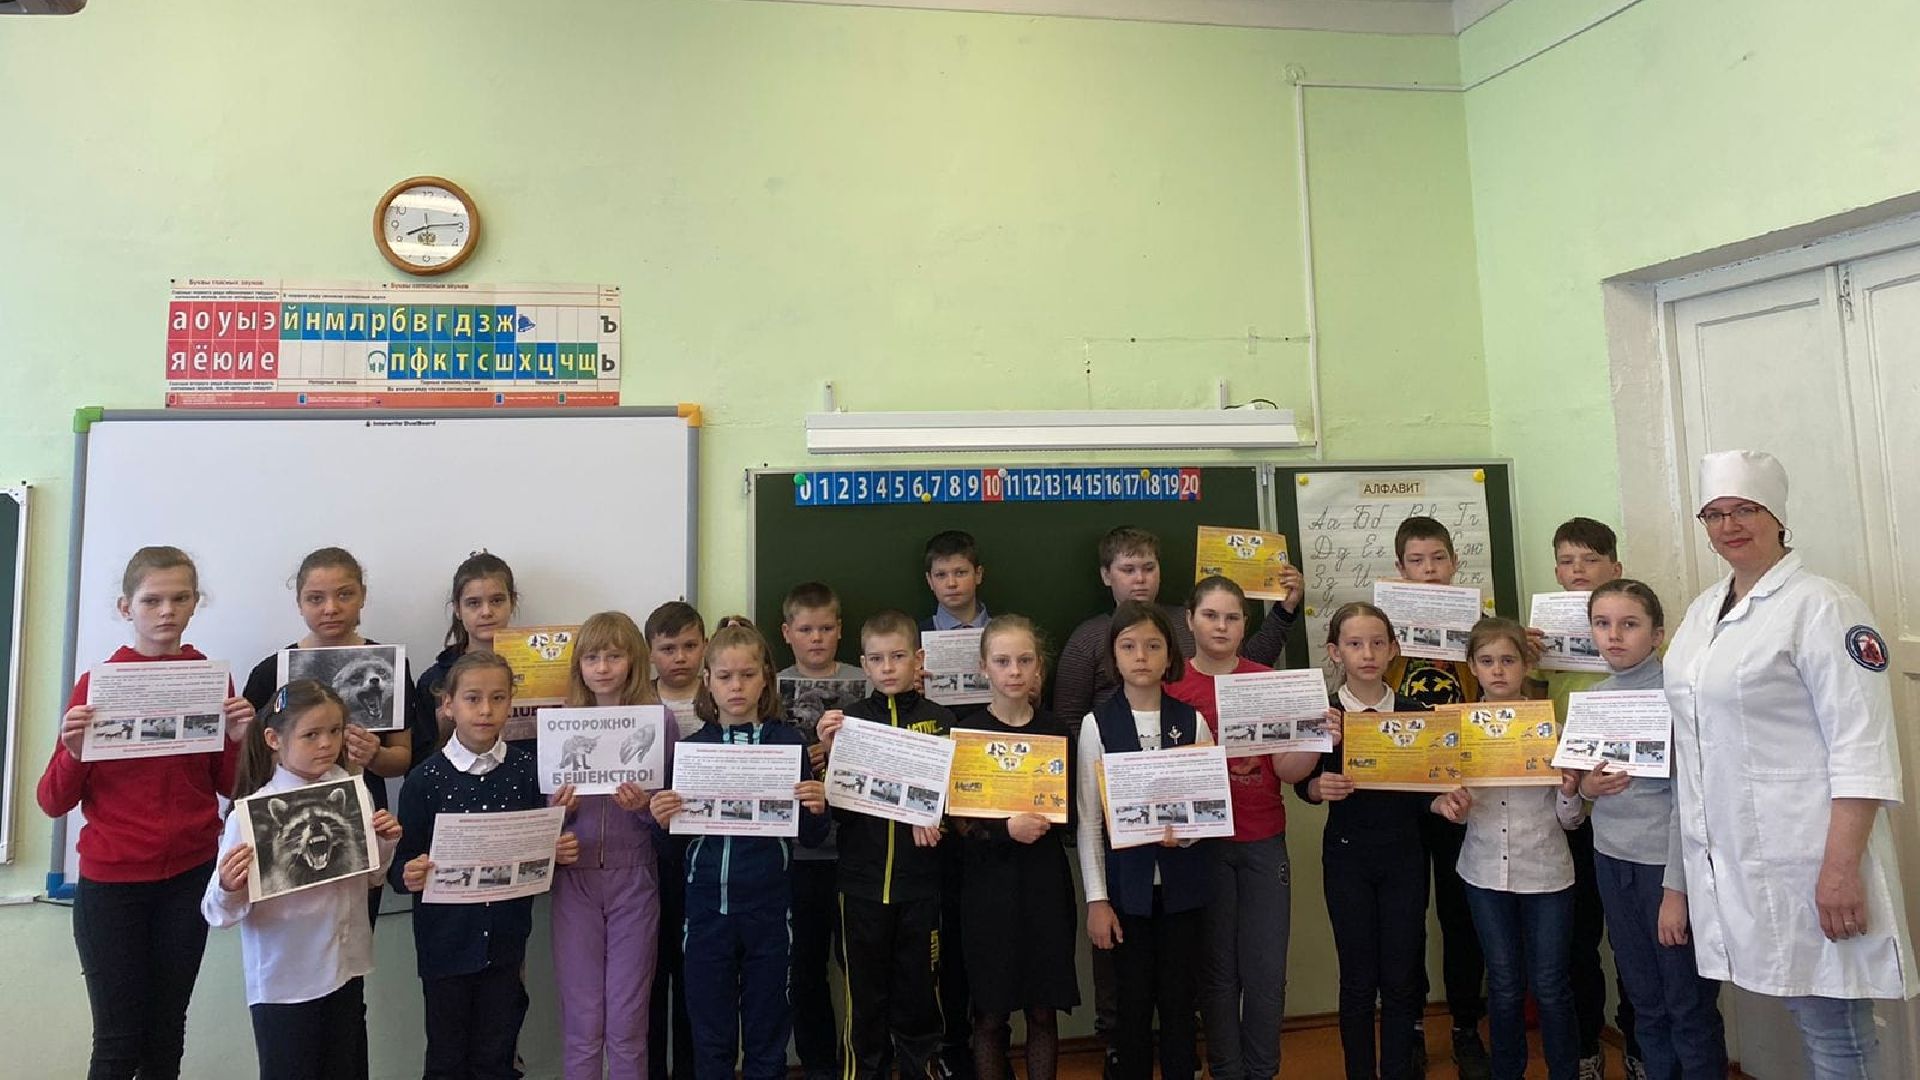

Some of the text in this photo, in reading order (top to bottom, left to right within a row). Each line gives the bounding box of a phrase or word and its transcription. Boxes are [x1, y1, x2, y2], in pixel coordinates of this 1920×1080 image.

[819, 478, 829, 500] 1
[838, 477, 849, 500] 2
[857, 477, 868, 499] 3
[876, 477, 887, 499] 4
[895, 477, 904, 498] 5
[931, 476, 941, 497] 7
[949, 475, 961, 496] 8
[968, 475, 979, 496] 9
[984, 475, 1000, 496] 10
[1004, 475, 1019, 496] 11
[1024, 475, 1041, 495] 12
[1045, 475, 1060, 495] 13
[1065, 475, 1082, 495] 14
[1086, 475, 1101, 495] 15
[1105, 475, 1121, 495] 16
[1124, 475, 1139, 495] 17
[1163, 475, 1179, 495] 19
[1363, 482, 1420, 495] АЛФАВИТ
[547, 717, 636, 731] ОСТОРОЖНО!
[552, 768, 653, 785] БЕШЕНСТВО!
